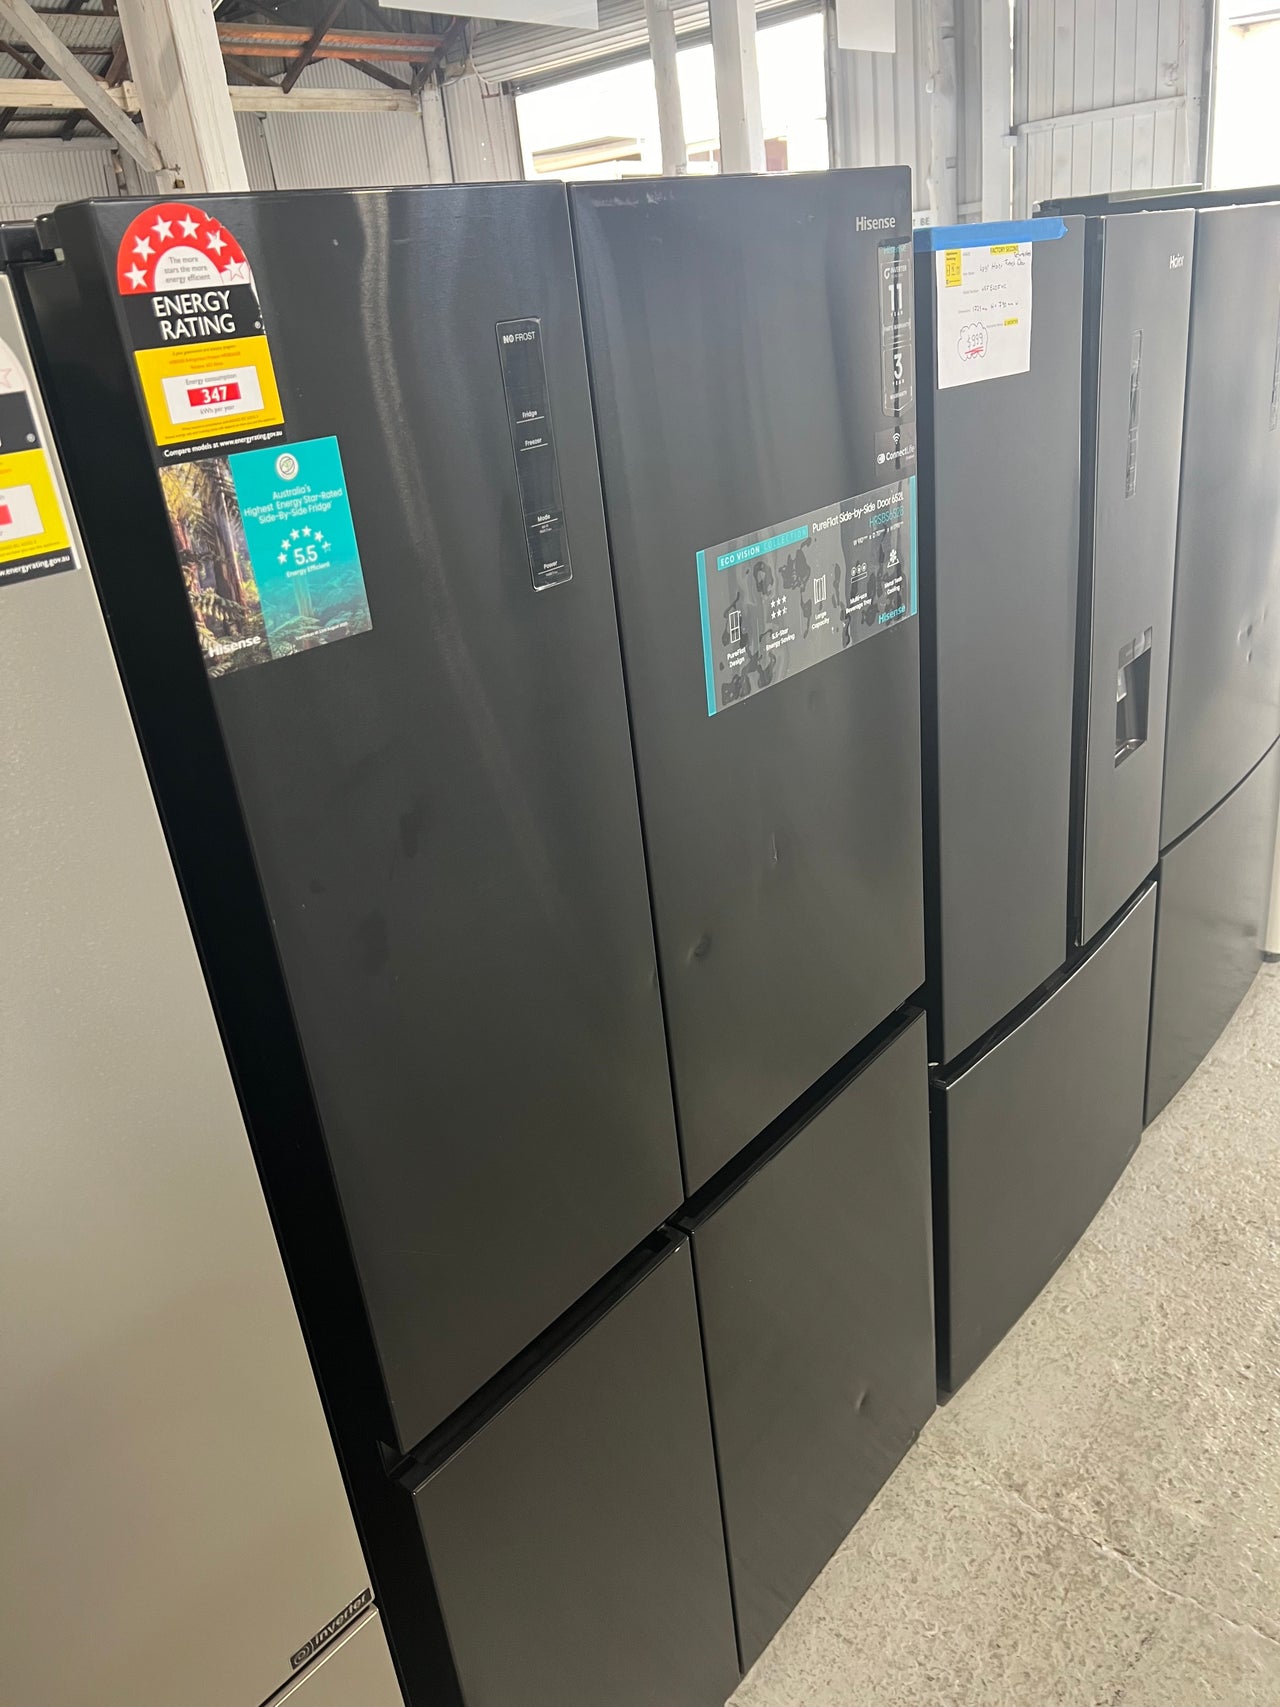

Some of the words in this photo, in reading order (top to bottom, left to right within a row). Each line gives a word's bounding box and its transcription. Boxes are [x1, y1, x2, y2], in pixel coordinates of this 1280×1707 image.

[855, 216, 896, 232] Hisense
[169, 256, 182, 265] The
[182, 256, 199, 264] more
[164, 266, 180, 275] stars
[180, 265, 191, 273] the
[191, 264, 208, 273] more
[165, 275, 186, 285] energy
[187, 273, 211, 282] efficient
[152, 290, 231, 318] ENERGY
[888, 283, 903, 311] 11
[160, 313, 237, 341] RATING
[503, 334, 515, 344] NO
[515, 331, 536, 342] FROST
[894, 353, 903, 380] 3
[185, 376, 204, 386] Energy
[201, 385, 228, 404] 347
[522, 410, 538, 418] Fridge
[163, 447, 192, 458] Compare
[191, 443, 213, 452] models
[219, 430, 284, 448] www.energyrating.gov.au
[525, 438, 542, 447] Freezer
[272, 484, 312, 500] Australia's
[244, 502, 275, 517] Highest
[275, 498, 303, 510] Energy
[302, 488, 343, 503] Star-Rated
[259, 508, 308, 524] Side-By-Side
[537, 514, 551, 522] Mode
[811, 515, 840, 533] PureFlat
[839, 502, 876, 523] Side-by-Side
[876, 496, 892, 511] Door
[720, 554, 735, 567] ECO
[736, 545, 761, 560] VISION
[763, 526, 808, 551] COLLECTION
[293, 544, 319, 566] 5.5
[286, 568, 307, 578] Energy
[307, 561, 331, 572] Efficient
[543, 561, 558, 570] Power
[814, 611, 828, 621] Large
[878, 604, 906, 625] Hisense
[811, 618, 830, 630] Capacity
[207, 635, 262, 658] Hisense
[765, 640, 781, 652] Energy
[780, 633, 796, 645] Saving
[726, 647, 747, 661] PureFlat
[729, 656, 746, 668] Design
[314, 1592, 367, 1646] Inverter
